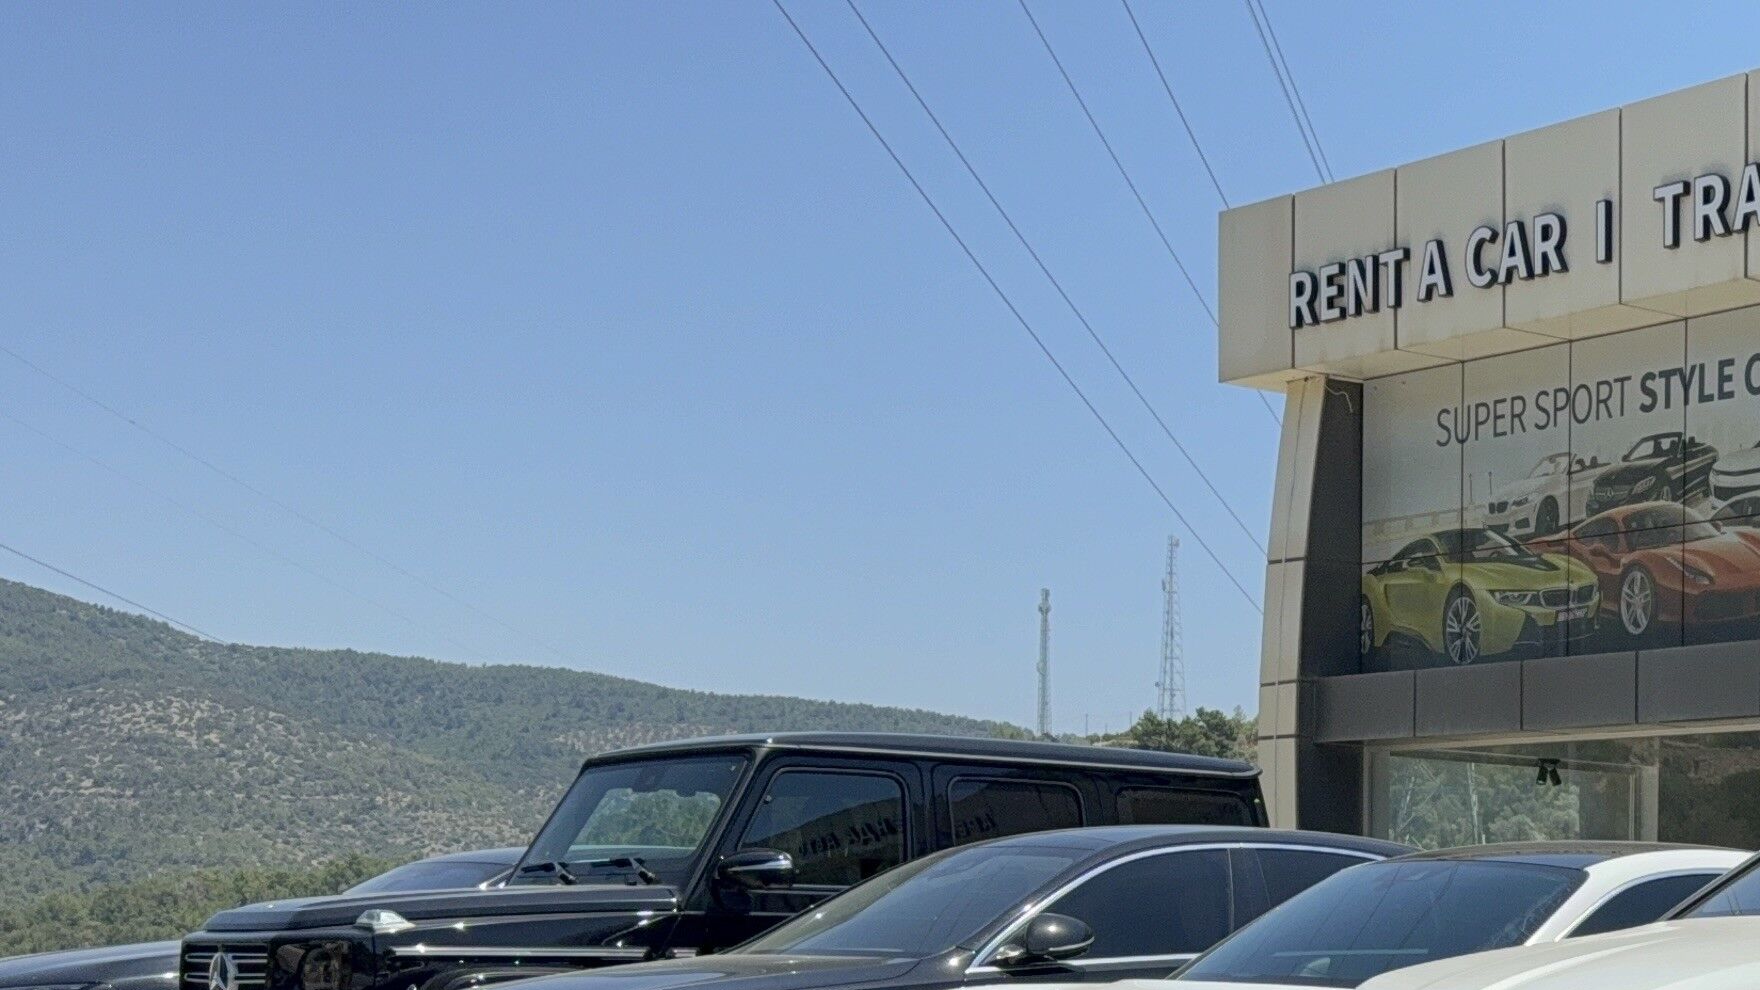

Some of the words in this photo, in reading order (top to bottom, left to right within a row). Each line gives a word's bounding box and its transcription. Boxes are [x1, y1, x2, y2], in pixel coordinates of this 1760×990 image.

[1290, 247, 1406, 328] RENT
[1418, 240, 1452, 303] A
[1465, 212, 1568, 290] CAR
[1436, 395, 1527, 447] SUPER
[1534, 376, 1632, 431] SPORT
[1639, 357, 1736, 413] STYLE
